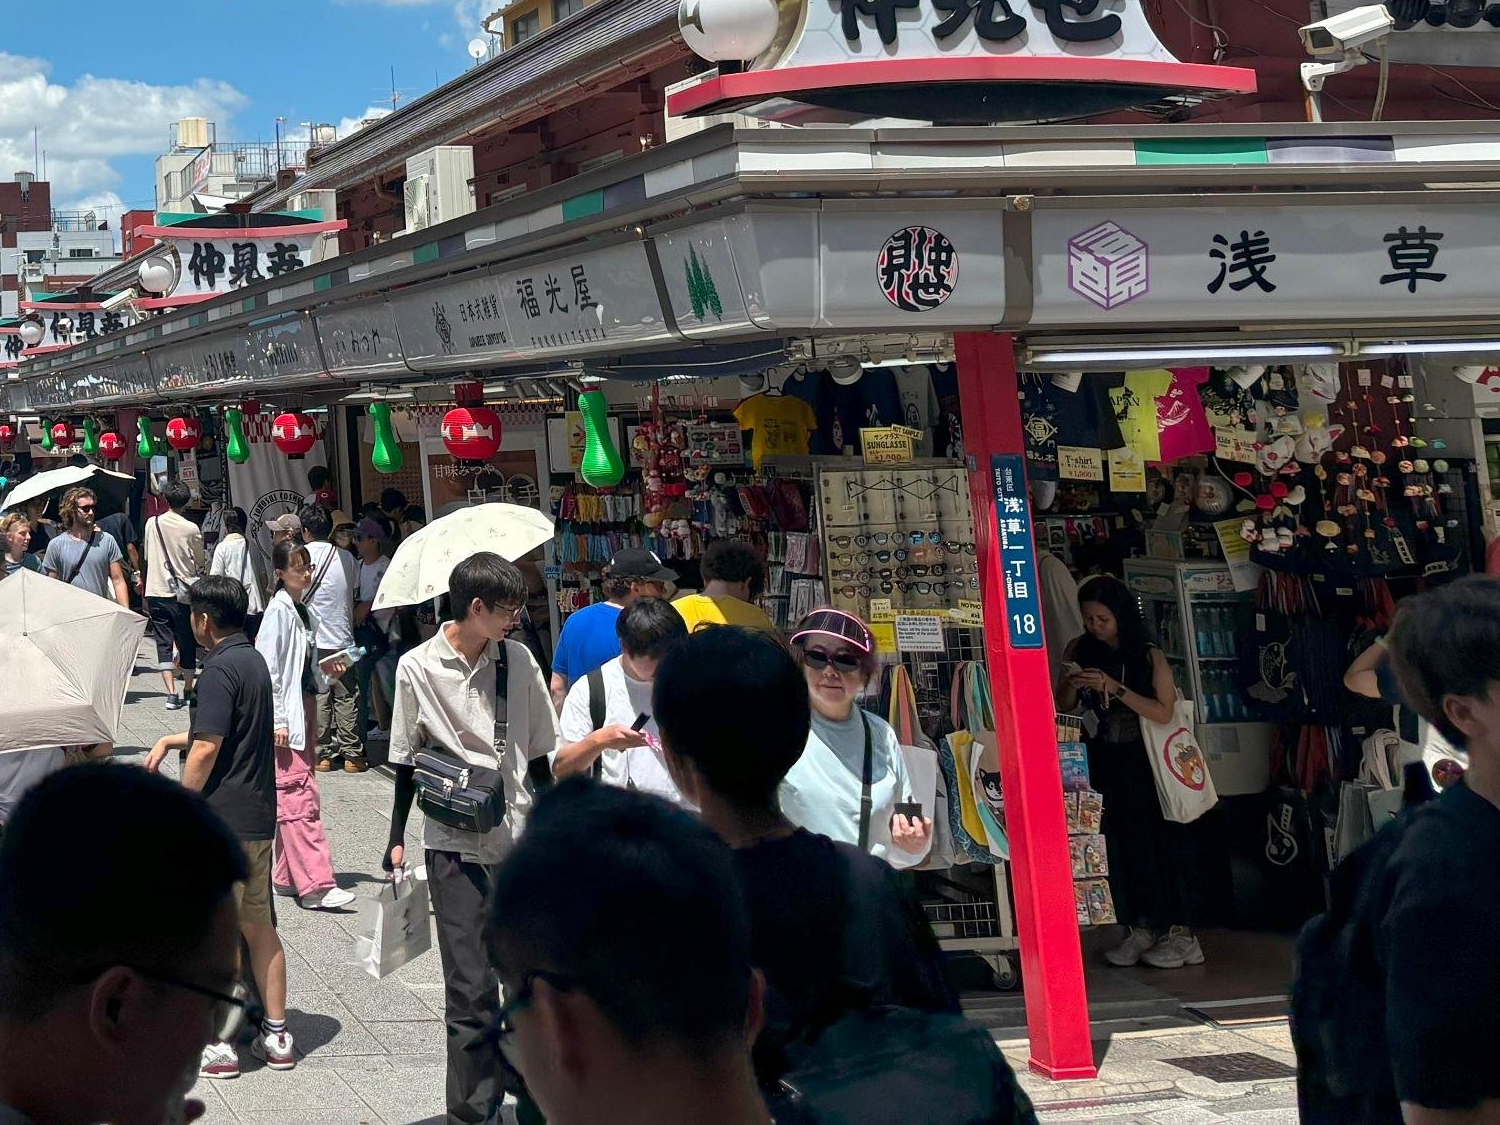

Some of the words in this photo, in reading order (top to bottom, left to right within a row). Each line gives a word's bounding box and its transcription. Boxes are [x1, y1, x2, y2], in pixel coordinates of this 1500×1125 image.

[1207, 228, 1448, 293] 浅草
[516, 264, 599, 319] 福光屋
[1003, 497, 1028, 598] 浅草一丁目
[1013, 613, 1036, 635] 18
